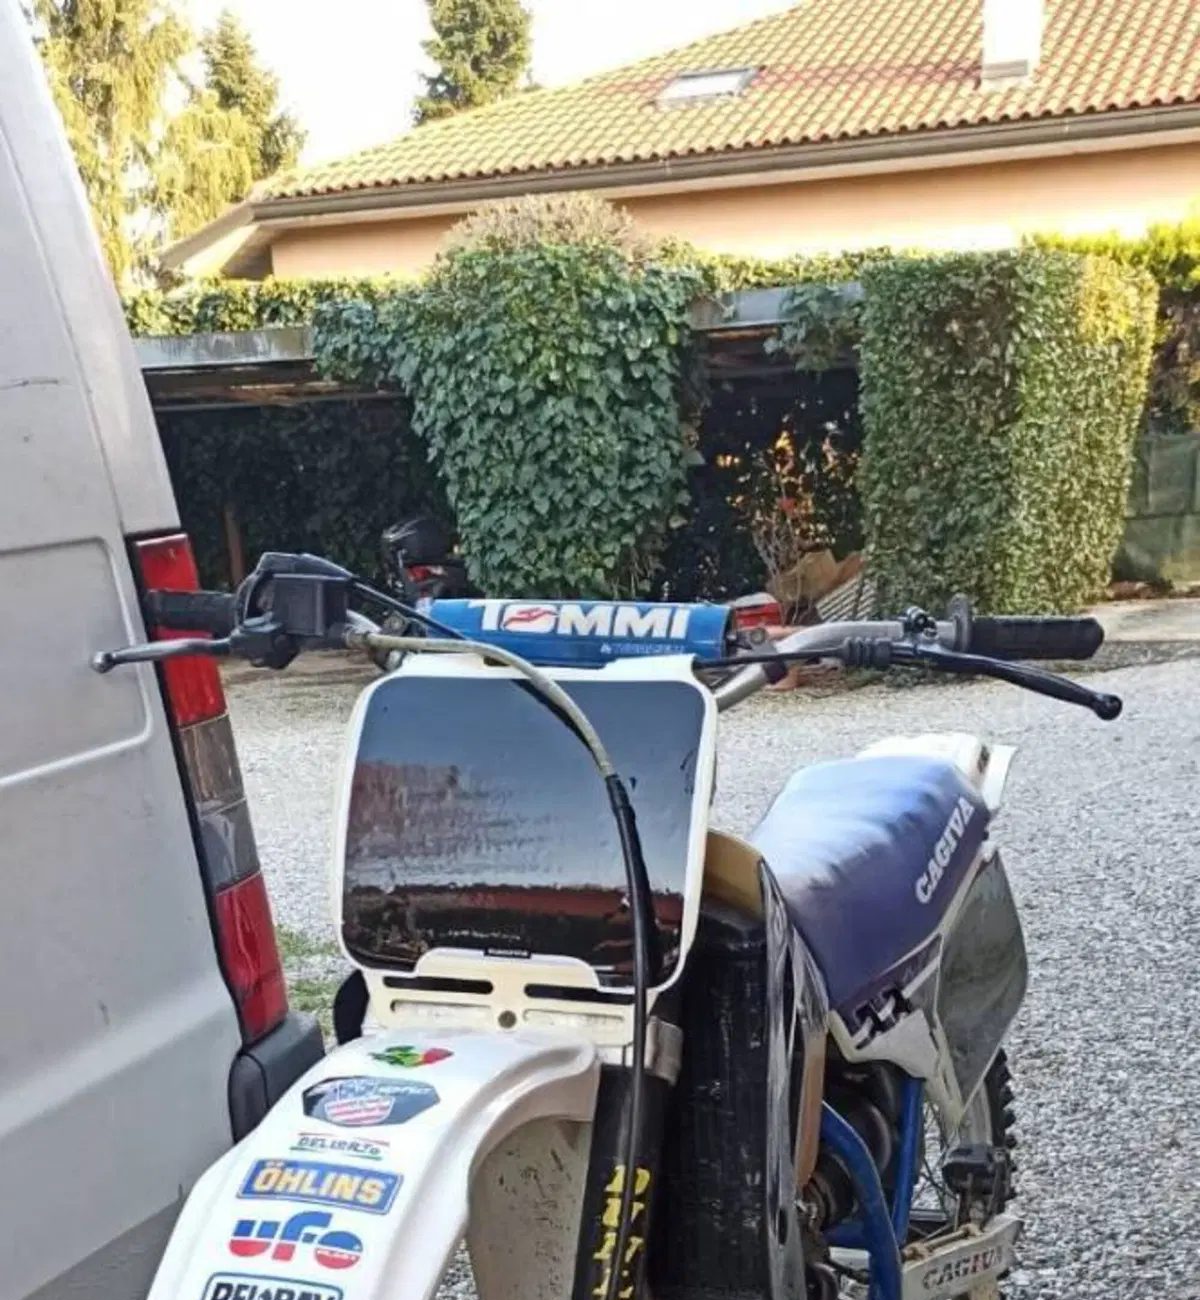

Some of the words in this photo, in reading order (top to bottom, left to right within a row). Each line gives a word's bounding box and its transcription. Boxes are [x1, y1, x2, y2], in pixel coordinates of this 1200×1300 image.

[468, 599, 691, 639] TOMMI
[915, 797, 976, 904] CAGIVA
[253, 1160, 387, 1205] ÖHLINS
